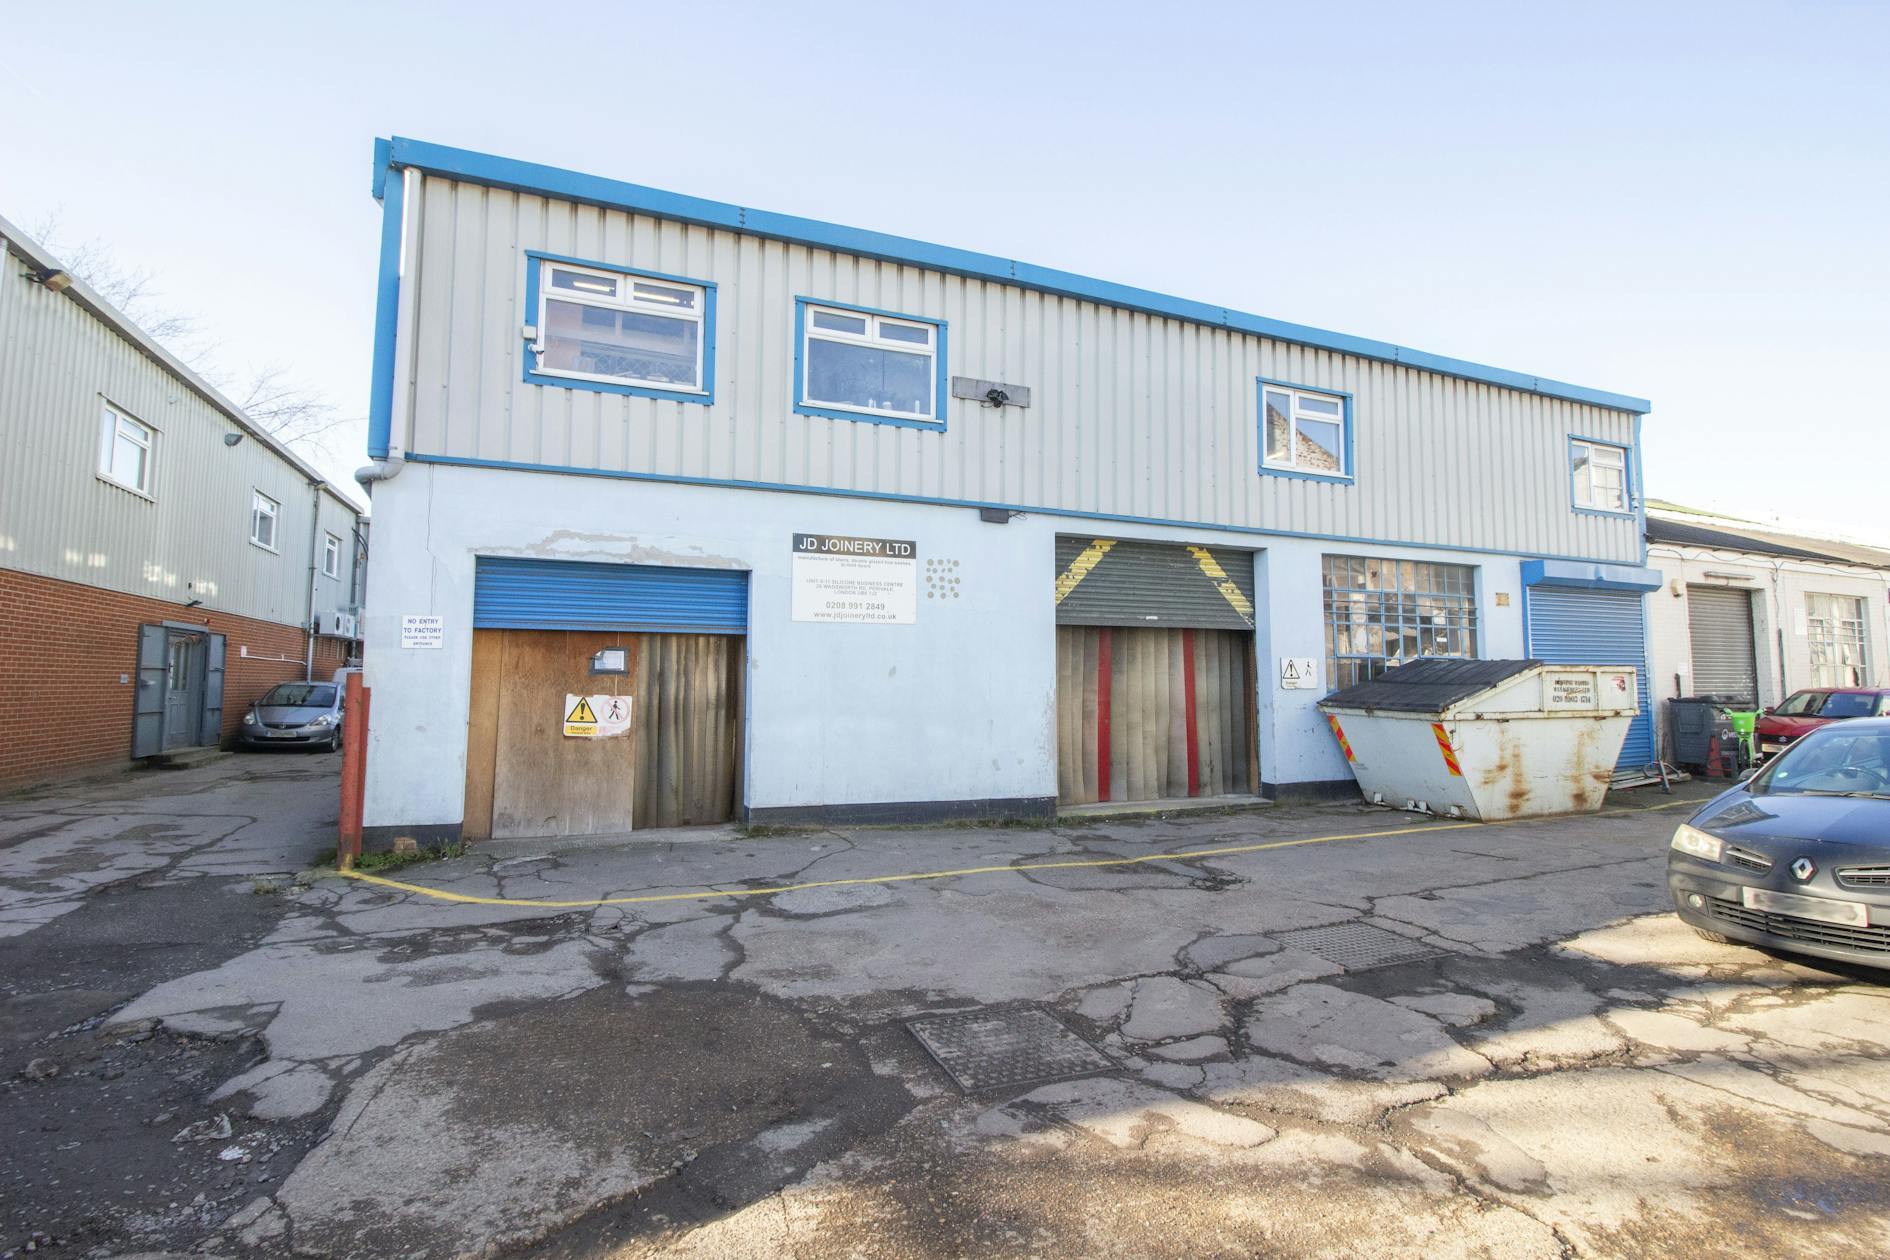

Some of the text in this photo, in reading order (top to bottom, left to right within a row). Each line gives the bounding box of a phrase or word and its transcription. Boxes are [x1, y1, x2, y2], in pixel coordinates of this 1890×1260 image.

[800, 538, 910, 555] JD JOINERY LTD
[866, 602, 885, 610] 2849
[814, 612, 896, 620] www.jdjoineryltd.co.uk
